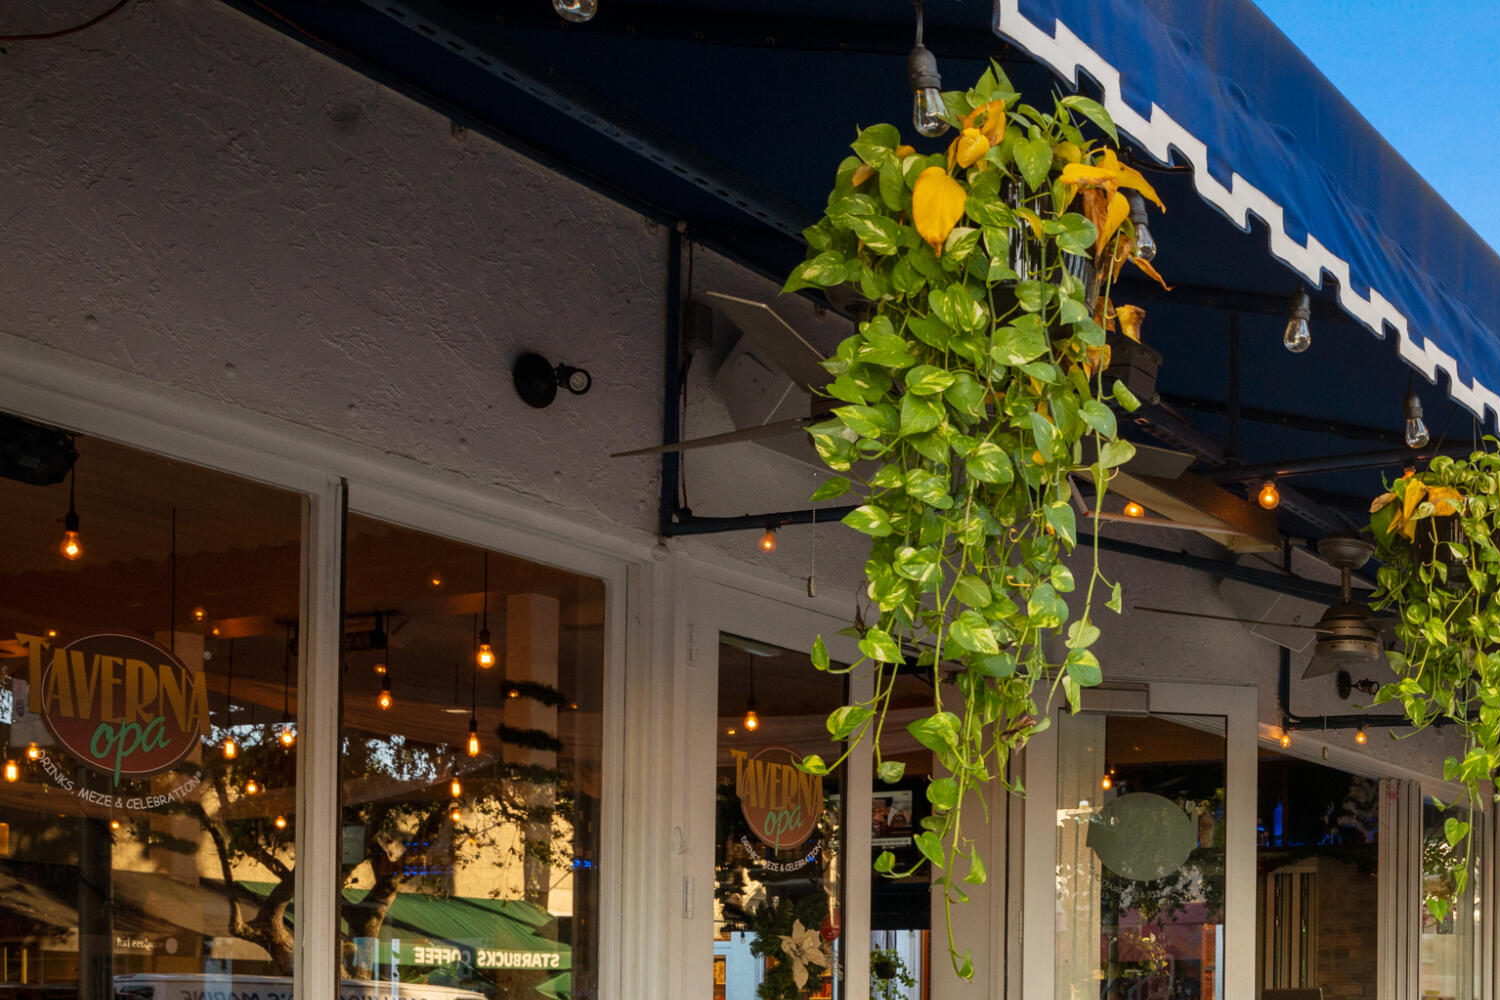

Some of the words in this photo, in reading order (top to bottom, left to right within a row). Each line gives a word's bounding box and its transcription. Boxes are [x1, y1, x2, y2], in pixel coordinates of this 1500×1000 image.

[15, 632, 212, 735] TAVERNA
[90, 716, 171, 787] opa
[731, 749, 824, 817] TAVERNA
[77, 787, 113, 808] MEZE
[114, 797, 123, 809] &
[763, 805, 804, 857] opa
